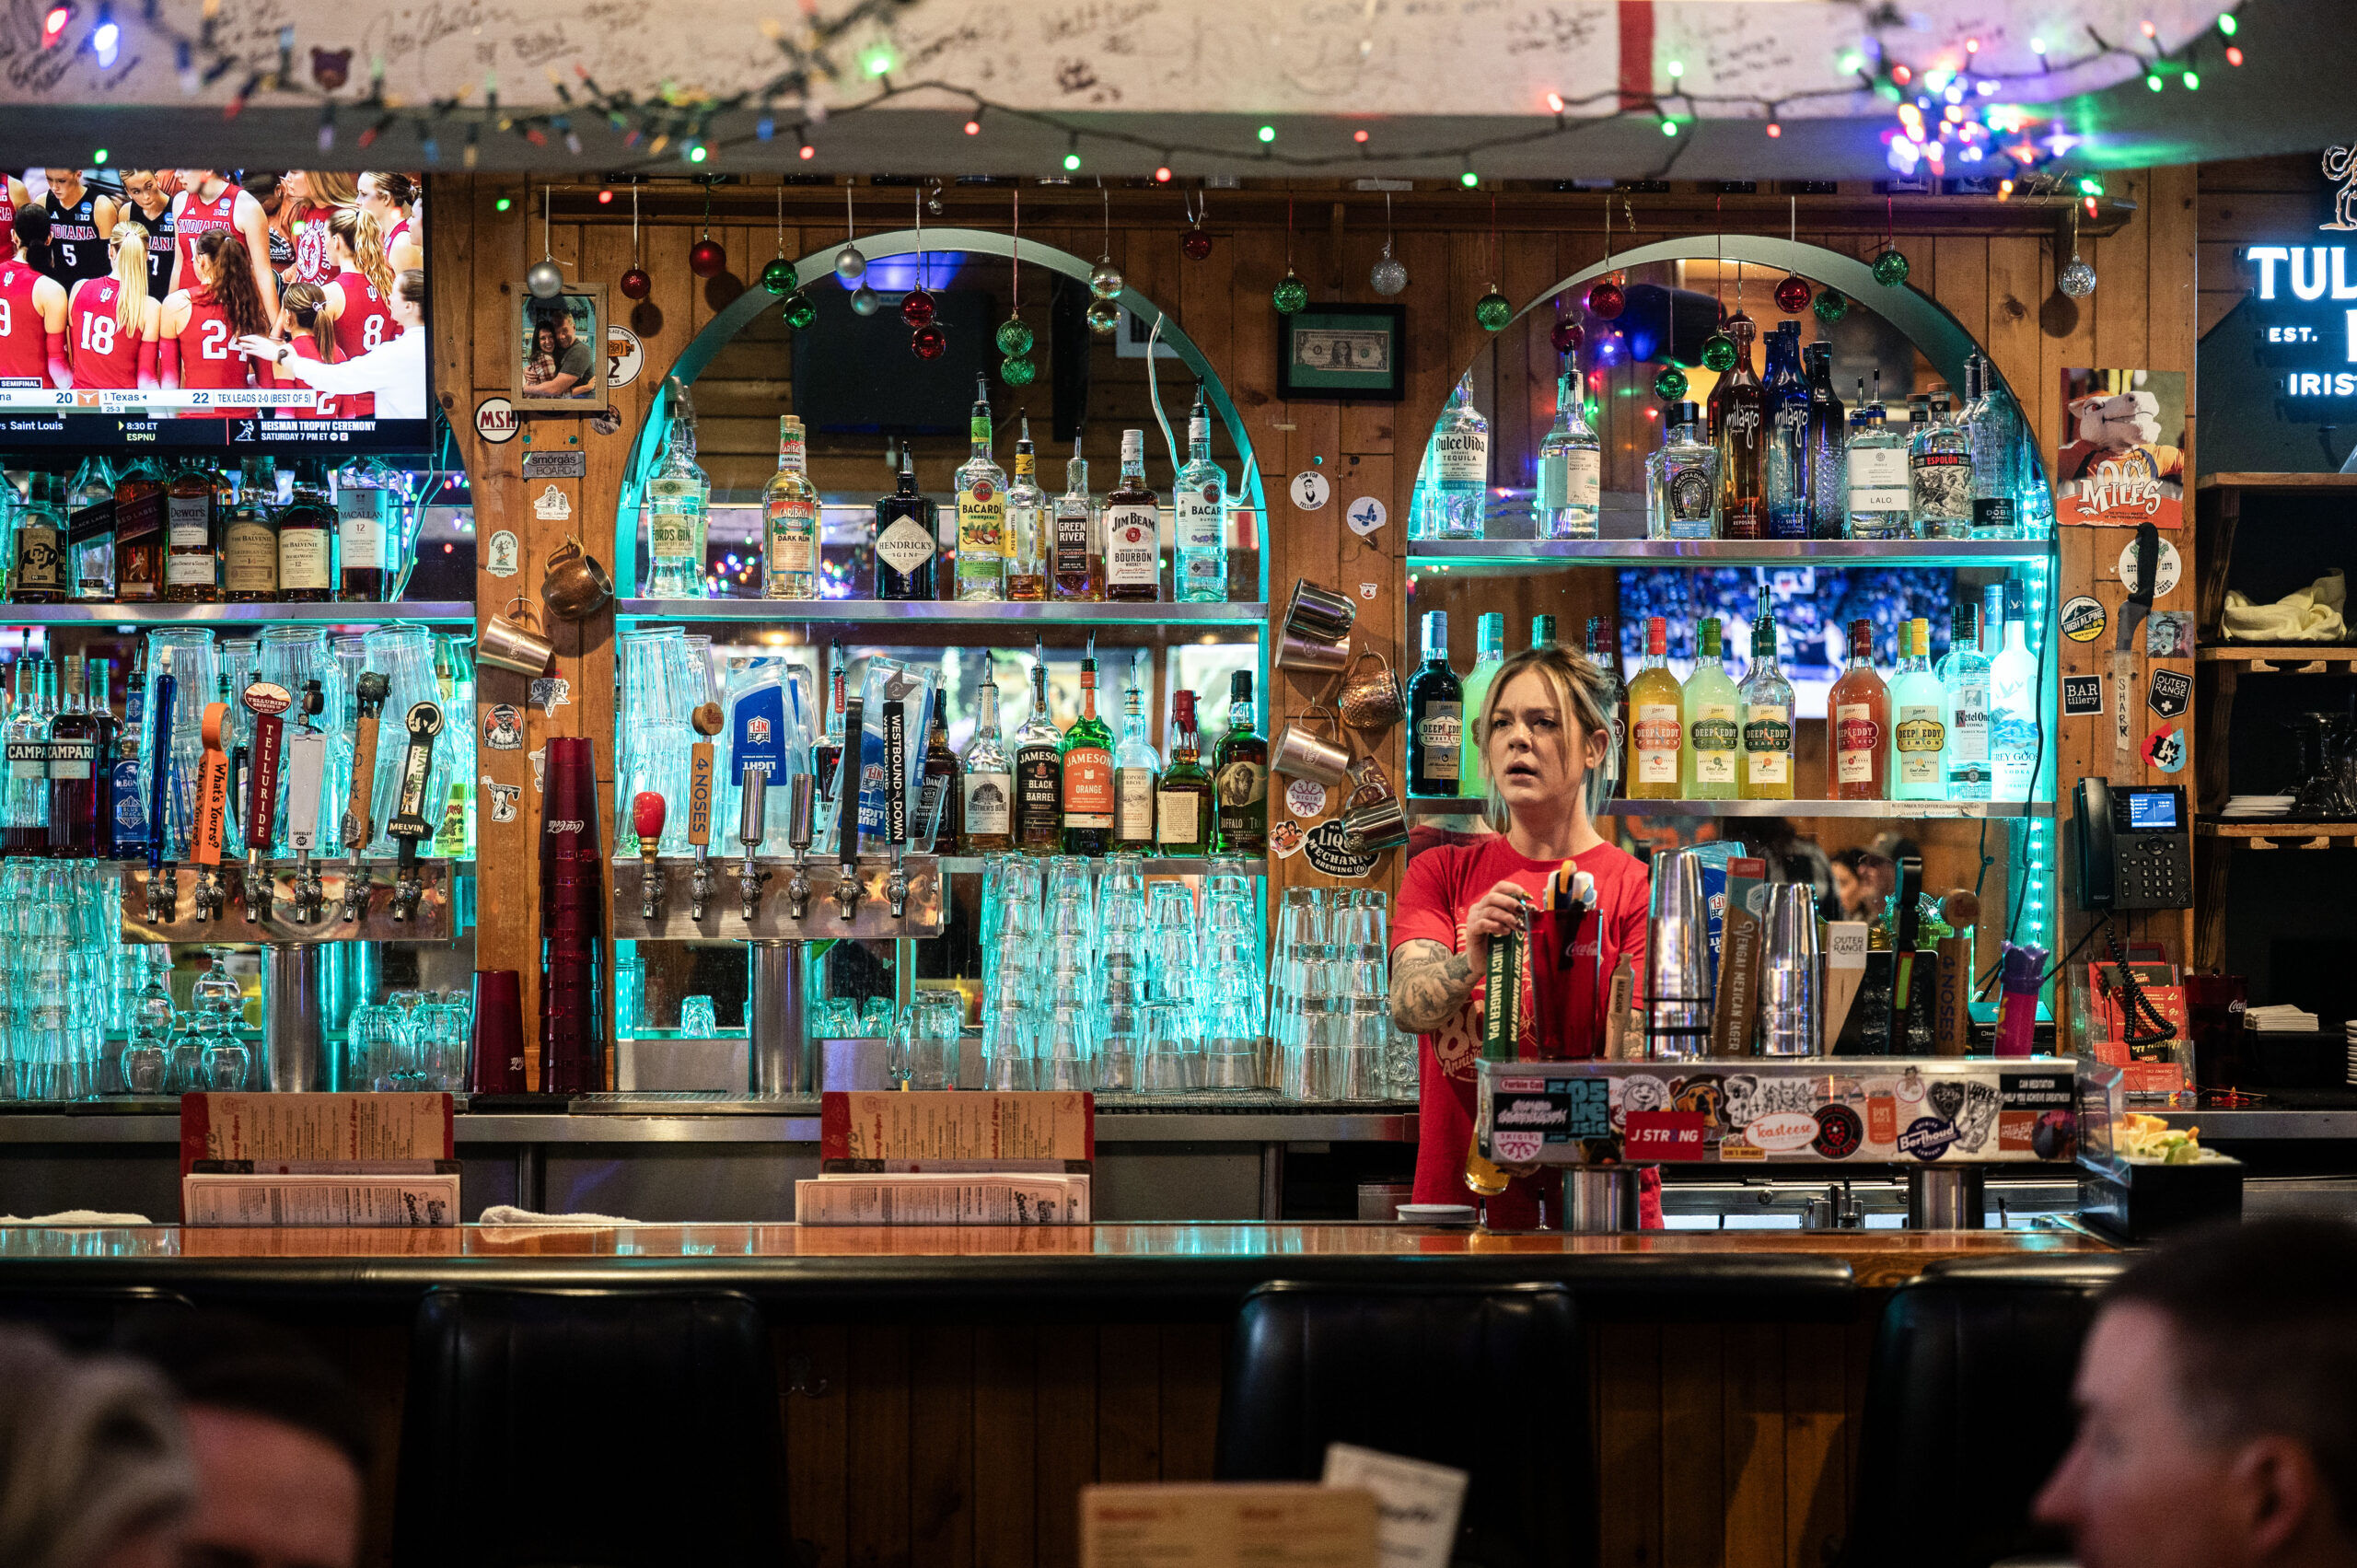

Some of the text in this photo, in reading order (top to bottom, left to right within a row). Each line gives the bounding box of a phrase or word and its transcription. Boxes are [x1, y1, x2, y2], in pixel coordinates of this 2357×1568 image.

[62, 244, 77, 266] 5
[148, 254, 158, 276] 7
[81, 310, 117, 356] 18
[363, 313, 383, 351] 8
[2269, 327, 2318, 343] EST.
[55, 392, 73, 404] 20
[110, 392, 140, 401] Texas
[192, 392, 210, 404] 22
[217, 393, 311, 403] TEX LEADS 2-0 (BEST OF 5)
[10, 421, 64, 431] Saint Louis
[126, 422, 158, 431] 8:30 ET
[261, 420, 377, 432] HEISMAN TROPHY CEREMONY
[1726, 399, 1759, 449] milagro
[1774, 398, 1808, 448] milagro
[126, 434, 156, 442] ESPNU
[261, 433, 329, 441] SATURDAY PM ET
[1435, 435, 1485, 452] Dulce Vida
[531, 454, 576, 466] smörgås
[1298, 472, 1309, 481] TOM
[1674, 472, 1709, 488] HERRADURA
[2078, 479, 2165, 517] MILES
[962, 503, 1002, 515] BACARDÍ
[1298, 500, 1323, 510] TELLURIDE
[116, 505, 157, 526] RED LABEL
[170, 507, 206, 517] Dewar's
[340, 511, 383, 519] MACALLAN
[779, 505, 808, 518] CARIBAYA
[355, 523, 366, 532] 12
[1058, 521, 1086, 532] GREEN
[1112, 512, 1156, 533] JIM BEAM
[678, 528, 691, 541] GIN
[1059, 531, 1086, 542] RIVER
[878, 540, 932, 551] HENDRICK'S
[1115, 552, 1152, 563] BOURBON
[2156, 579, 2174, 595] IDAHO
[2063, 610, 2106, 633] HIGH ALPINE
[2156, 675, 2189, 690] OUTER
[2066, 683, 2099, 697] BAR
[2154, 683, 2188, 697] RANGE
[248, 697, 287, 707] TELLURIDE
[2067, 696, 2098, 707] tillery
[2119, 678, 2130, 738] SHARK
[1955, 709, 1991, 727] Ketel One
[750, 721, 769, 733] NFL
[1422, 724, 1442, 734] DEEP
[1636, 728, 1680, 738] DEEP EDDY
[1694, 728, 1737, 738] DEEP EDDY
[1852, 726, 1873, 737] EDDY
[1898, 728, 1942, 738] DEEP EDDY
[1747, 729, 1789, 738] DEEP EDDY
[1019, 751, 1061, 764] JAMESON
[1066, 753, 1112, 768] JAMESON
[415, 746, 430, 793] MELVIN
[742, 761, 777, 771] LIGHT
[865, 767, 884, 780] NFL
[891, 714, 904, 841] WESTBOUND DOWN
[257, 724, 274, 838] TELLURIDE
[1028, 780, 1053, 789] BLACK
[692, 757, 710, 833] 4 NOSES
[1075, 784, 1102, 795] ORANGE
[1026, 792, 1055, 802] BARREL
[1291, 793, 1323, 803] SKIGIRL
[208, 762, 227, 849] What's Yours?
[968, 803, 994, 812] BROTHER'S
[389, 822, 425, 833] MELVIN
[1221, 817, 1243, 830] BUFFALO
[1315, 858, 1353, 873] BREWING
[1834, 935, 1864, 946] OUTER
[1833, 944, 1864, 952] RANGE
[1488, 943, 1504, 1041] JUICY BANGER IPA
[1939, 956, 1956, 1042] 4 NOSES
[1728, 971, 1746, 1051] MEXICAN LAGER
[2029, 1079, 2055, 1089] MEDITATION
[2026, 1093, 2071, 1103] ACHIEVE GREATNESS
[1630, 1129, 1641, 1142] J
[1898, 1122, 1955, 1151] Berthoud
